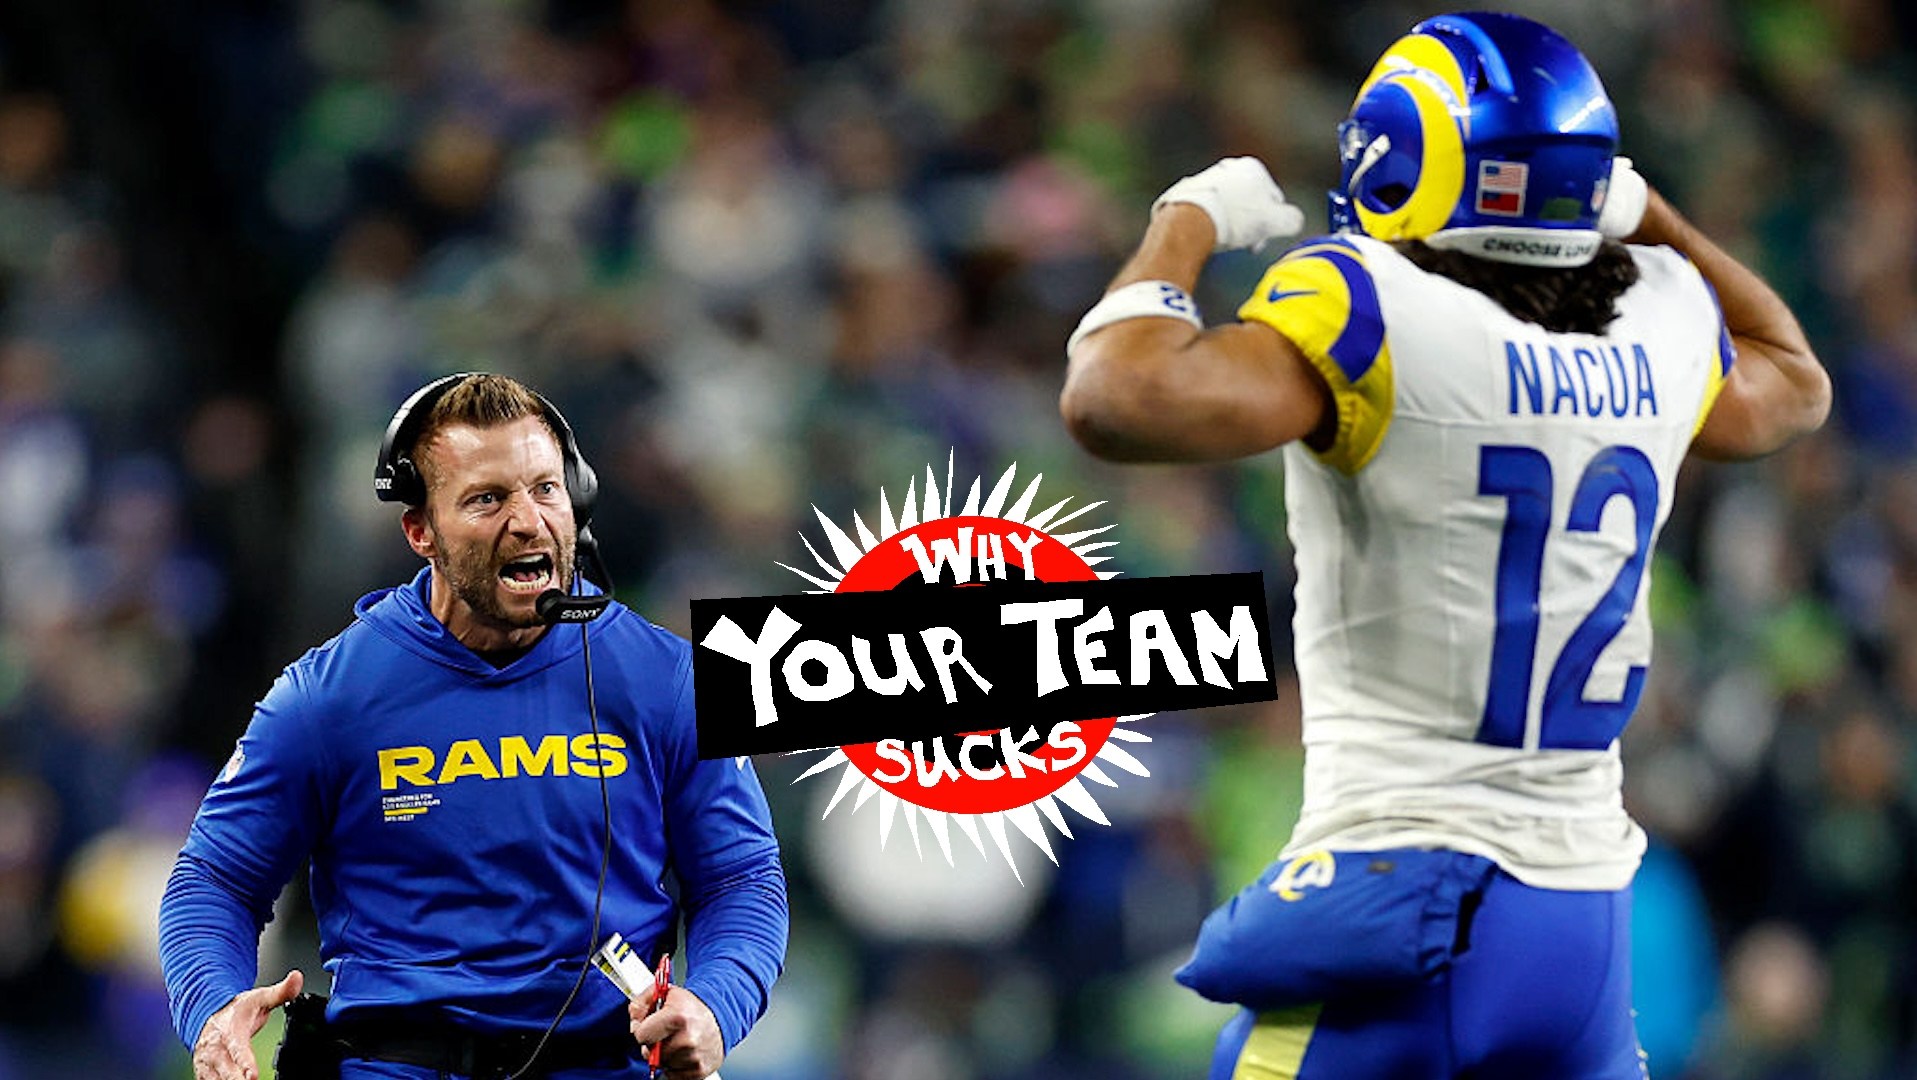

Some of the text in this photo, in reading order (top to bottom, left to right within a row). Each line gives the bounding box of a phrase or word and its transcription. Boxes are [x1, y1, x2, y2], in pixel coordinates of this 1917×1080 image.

[1505, 341, 1658, 418] NACUA
[561, 608, 601, 619] SONY
[1477, 445, 1659, 751] 12
[378, 733, 628, 790] RAMS
